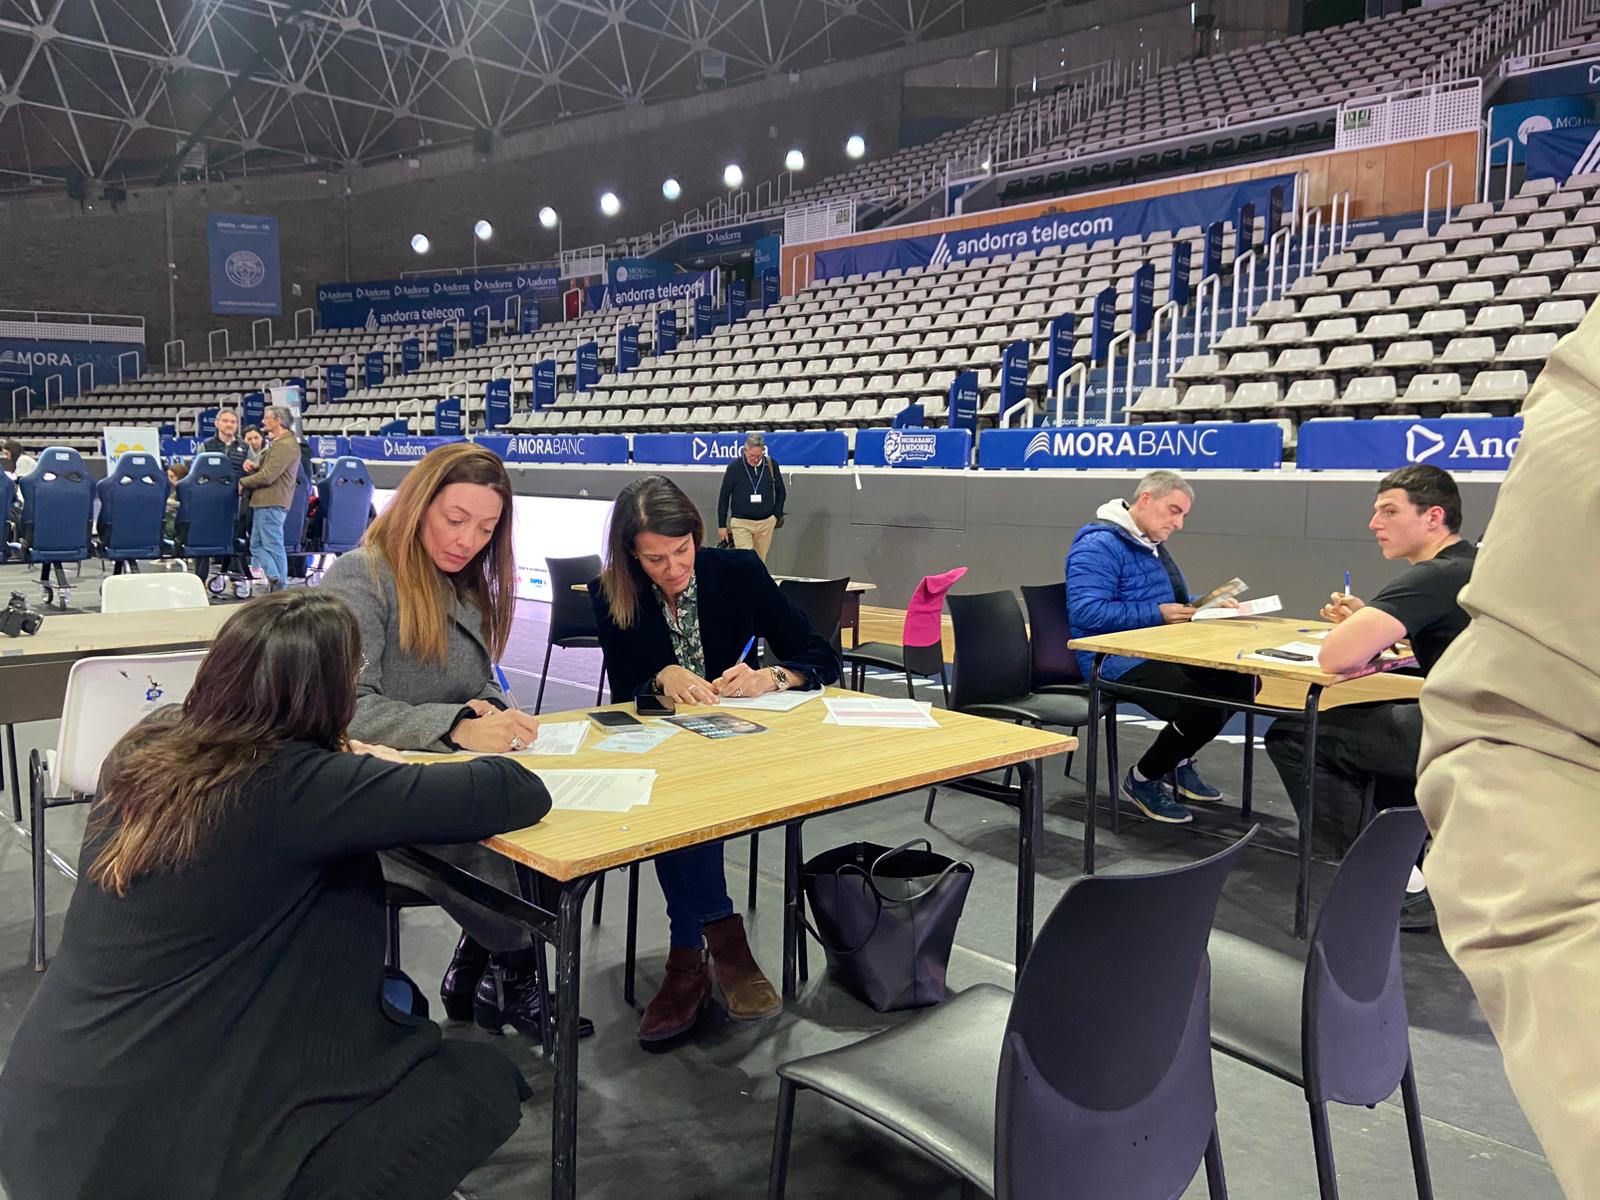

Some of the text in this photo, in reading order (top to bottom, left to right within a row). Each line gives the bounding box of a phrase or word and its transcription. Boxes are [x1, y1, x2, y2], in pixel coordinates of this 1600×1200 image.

[957, 217, 1113, 255] andorra telecom
[483, 280, 513, 289] Andorra
[527, 276, 557, 287] Andorra
[615, 287, 655, 303] andorra
[380, 307, 465, 323] andorra telecom
[393, 441, 427, 456] Andorra
[518, 438, 585, 455] MORABANC
[900, 443, 934, 453] ANDORRA
[1053, 428, 1219, 457] MORABANC
